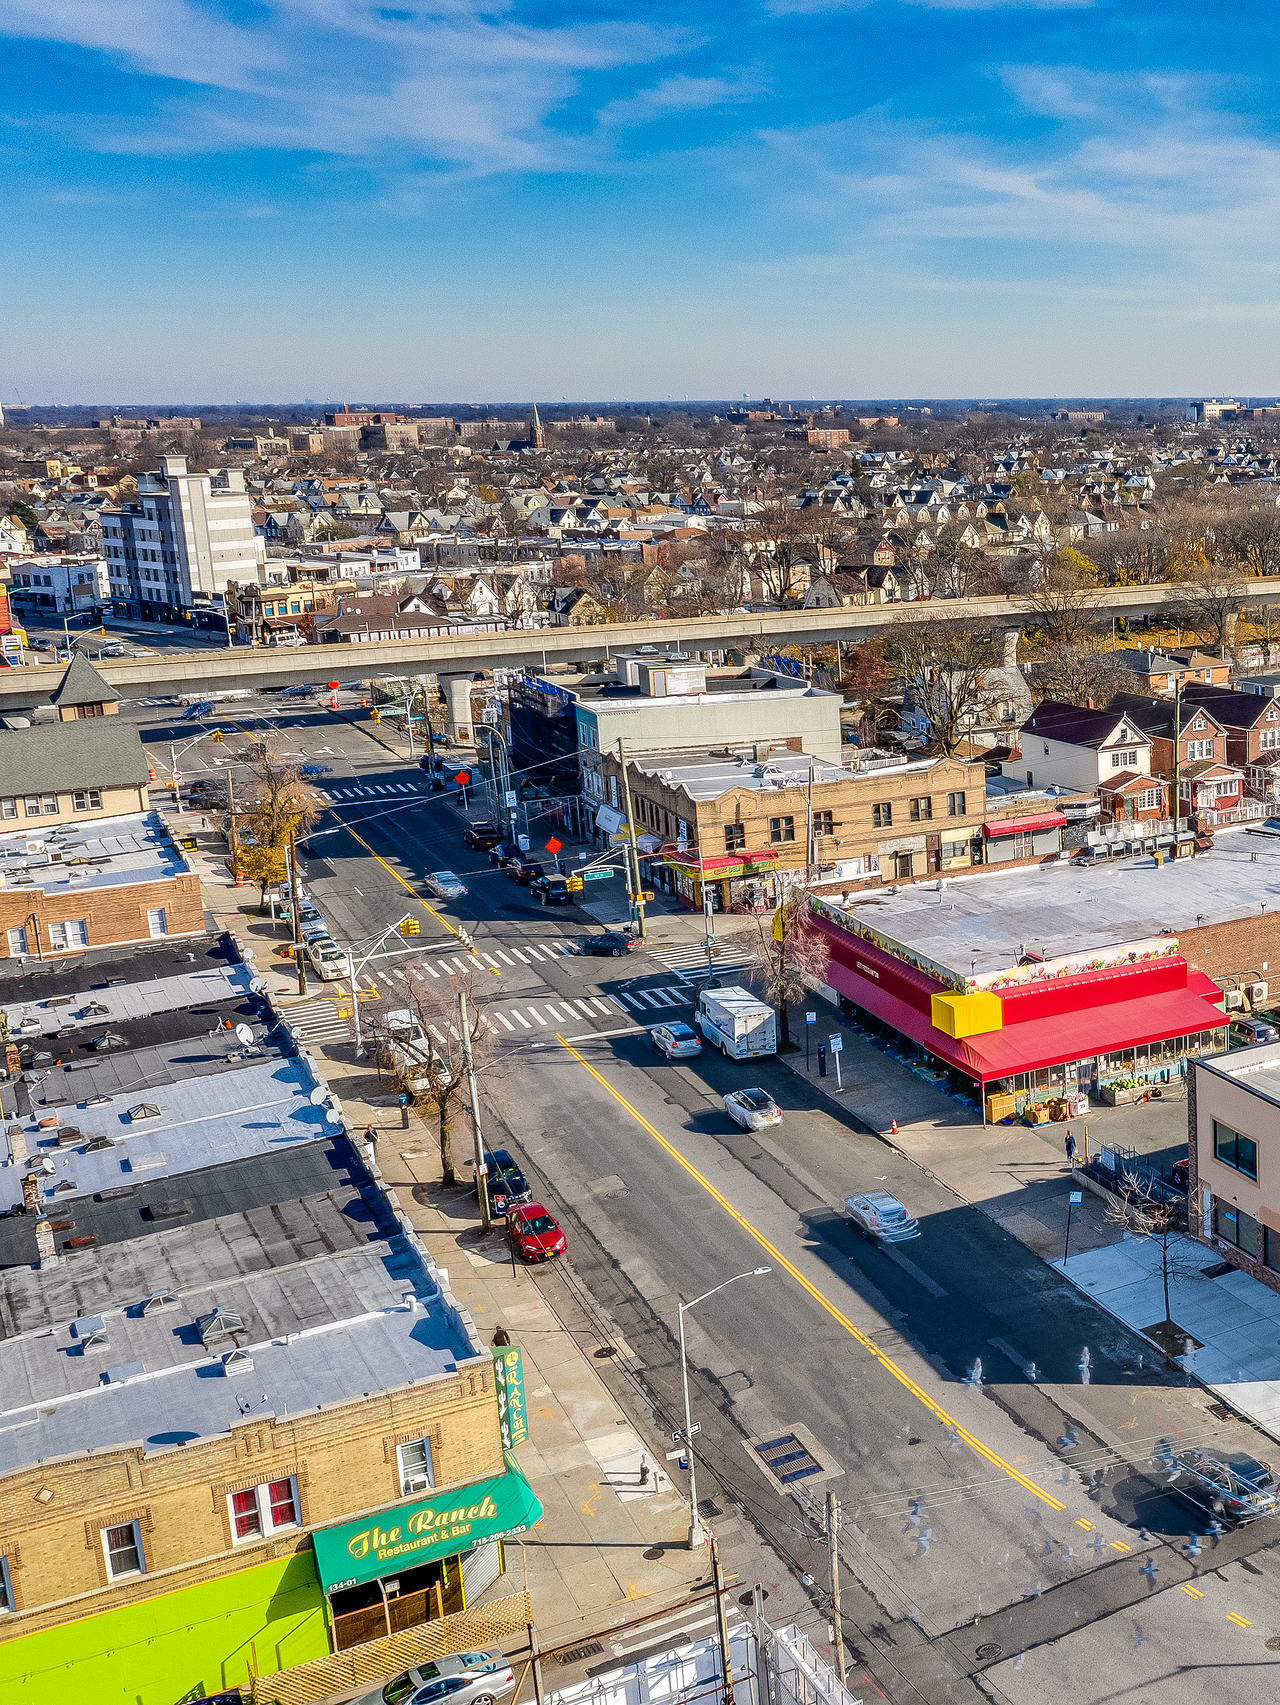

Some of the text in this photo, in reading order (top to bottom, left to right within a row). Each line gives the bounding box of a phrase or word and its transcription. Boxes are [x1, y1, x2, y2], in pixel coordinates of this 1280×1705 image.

[506, 1370, 524, 1431] RANCH
[348, 1496, 497, 1559] The Ranch
[377, 1522, 471, 1561] Restaurant & Bar
[471, 1524, 527, 1548] 718-206-2333
[328, 1577, 357, 1592] 134-01
